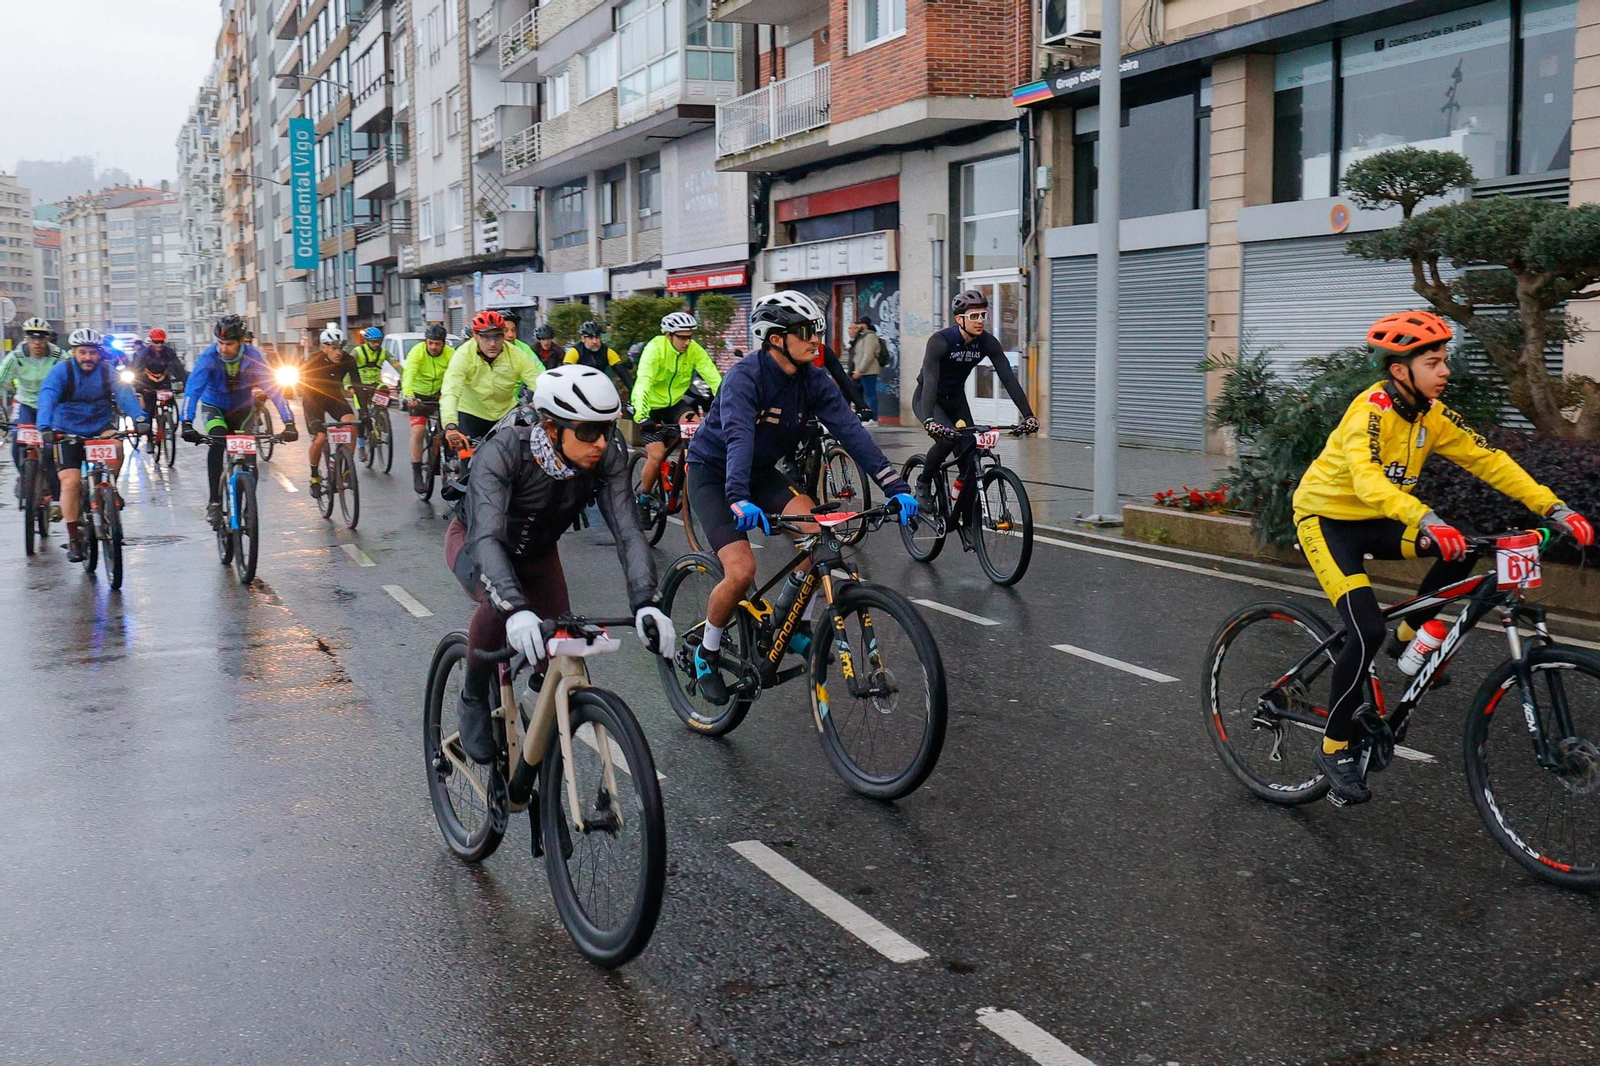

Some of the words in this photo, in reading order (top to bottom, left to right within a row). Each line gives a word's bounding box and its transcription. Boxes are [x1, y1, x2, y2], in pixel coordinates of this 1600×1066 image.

[1056, 75, 1079, 89] Grupo
[293, 130, 313, 167] Vigo
[295, 171, 313, 258] Occidental
[230, 441, 252, 450] 348
[331, 434, 348, 443] 182
[980, 433, 997, 445] 331
[90, 447, 112, 459] 432
[768, 574, 816, 664] MONDRAKER
[839, 651, 854, 680] FOX
